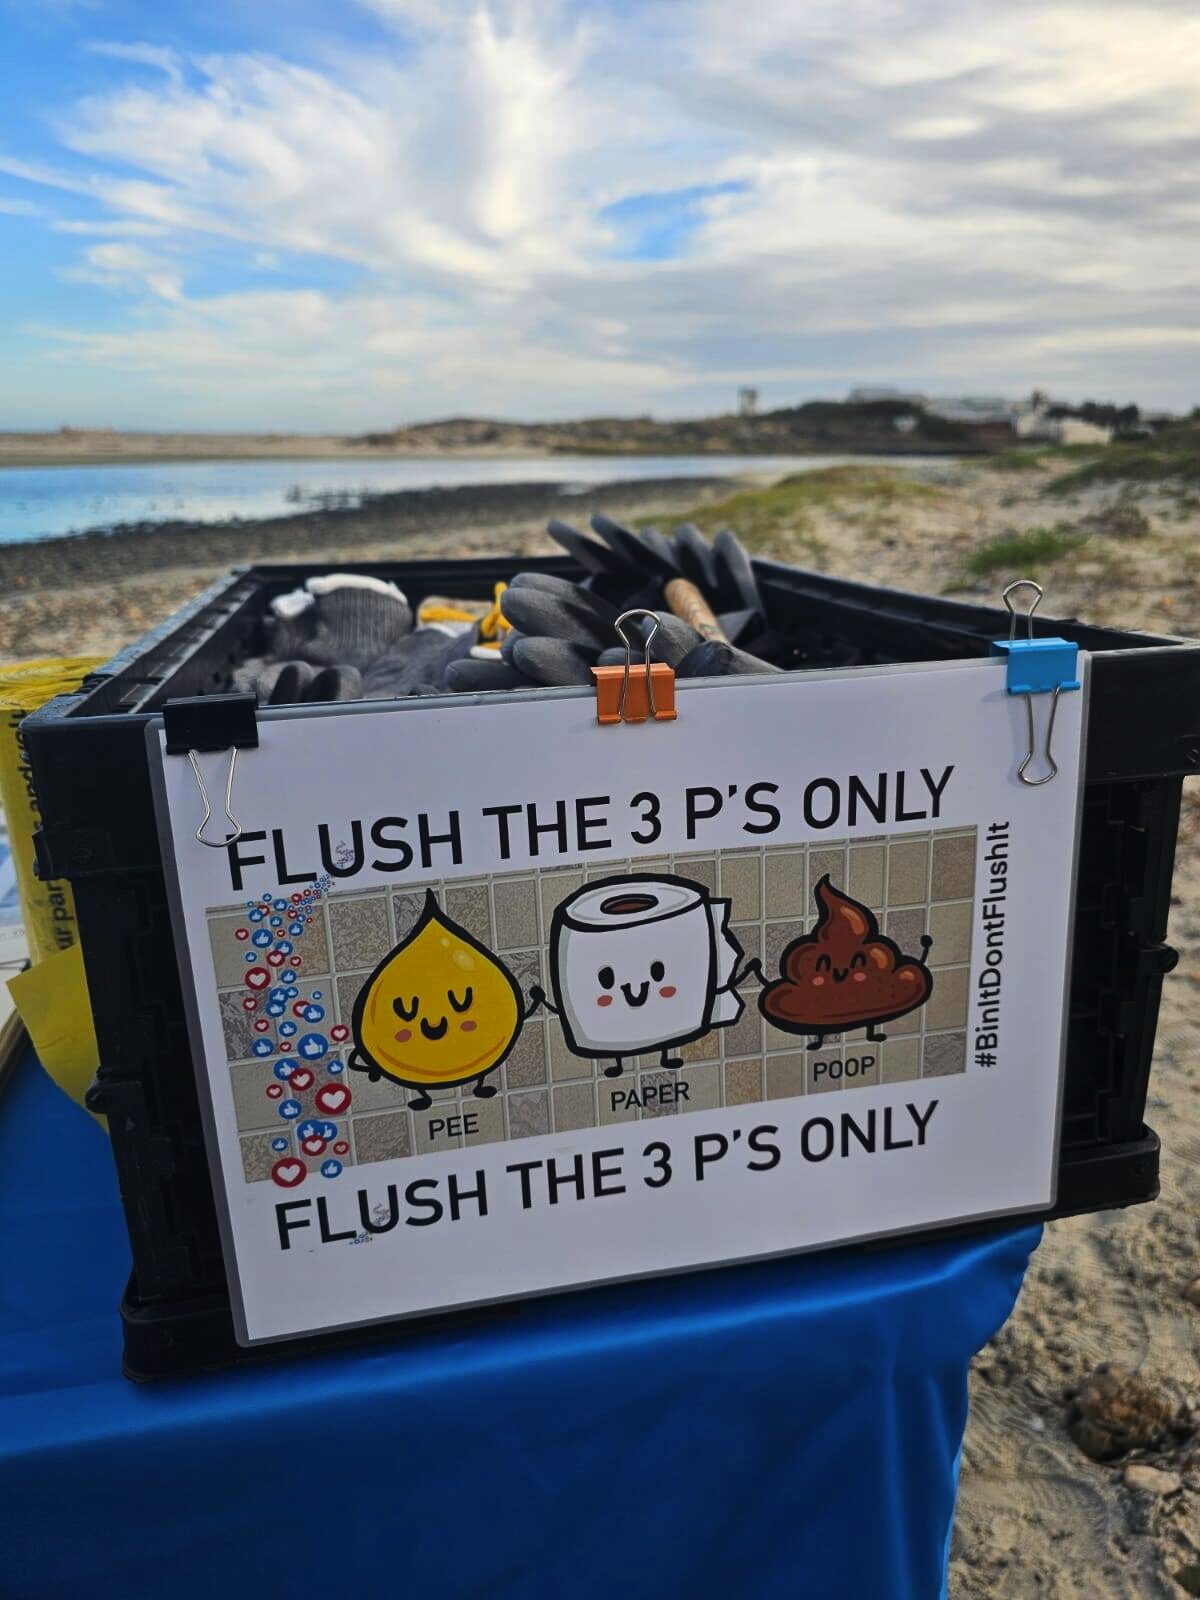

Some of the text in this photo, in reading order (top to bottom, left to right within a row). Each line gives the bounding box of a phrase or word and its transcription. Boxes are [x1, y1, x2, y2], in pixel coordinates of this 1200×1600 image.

[225, 765, 955, 891] FLUSH THE 3 P'S ONLY
[974, 820, 1010, 1068] #BinItDontFlushIt
[610, 1081, 690, 1112] PAPER
[813, 1055, 876, 1083] POOP
[428, 1112, 480, 1141] PEE
[274, 1099, 940, 1251] FLUSH THE 3 P'S ONLY
